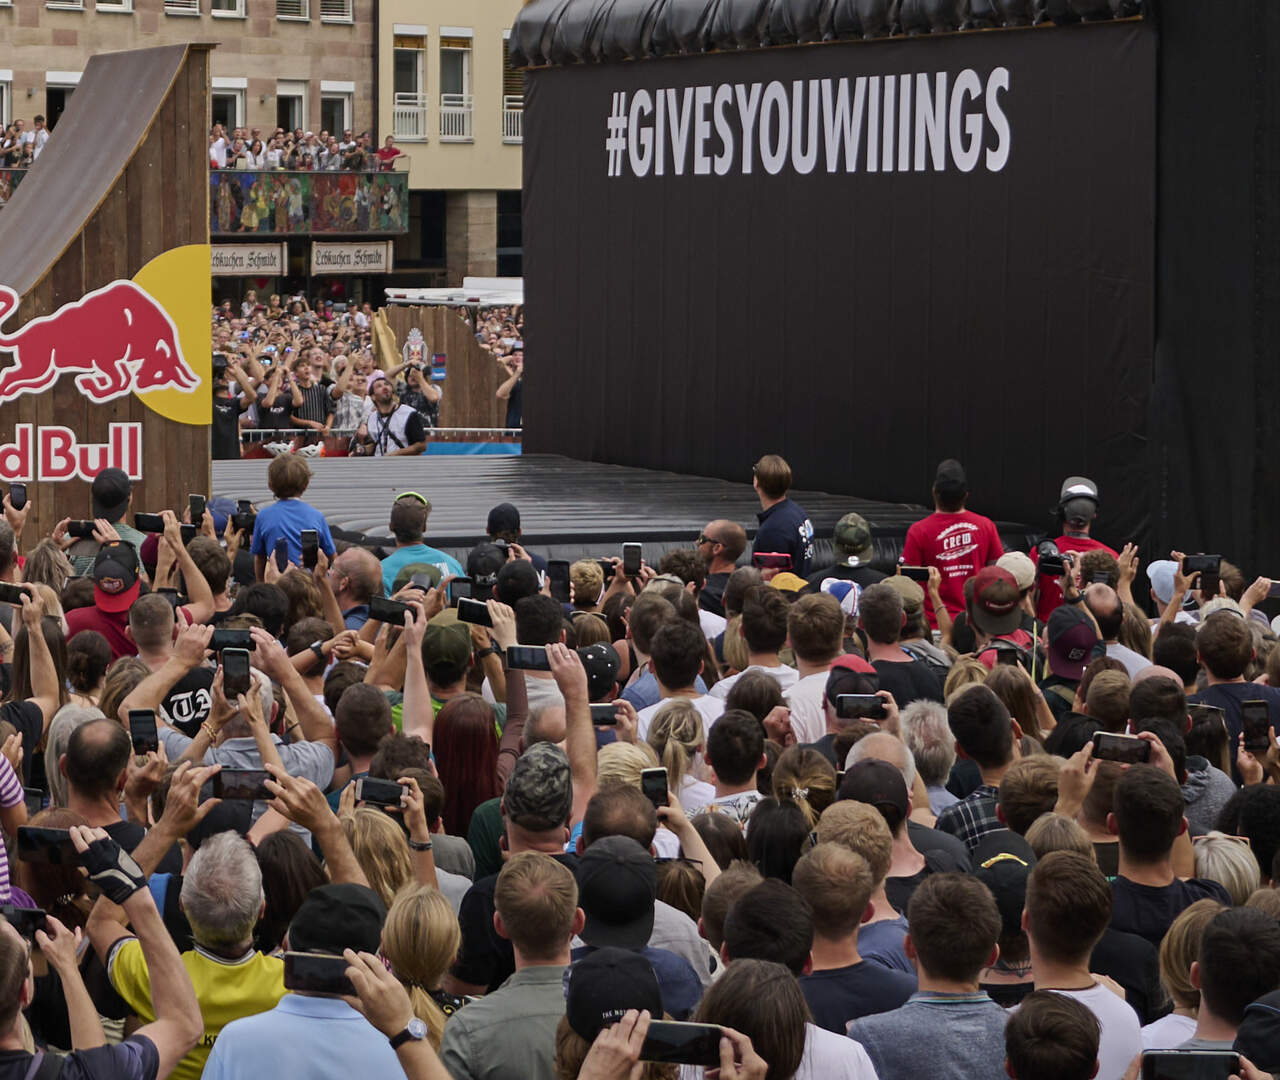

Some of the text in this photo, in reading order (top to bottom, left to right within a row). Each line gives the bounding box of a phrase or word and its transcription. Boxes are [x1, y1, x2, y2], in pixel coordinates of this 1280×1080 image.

[606, 66, 1011, 177] #GIVESYOUWIIINGS
[211, 251, 278, 270] ebkuchen Schmidt
[315, 248, 383, 267] Lebkuchen Schmidt
[37, 422, 142, 482] Bull
[943, 532, 972, 550] CREW
